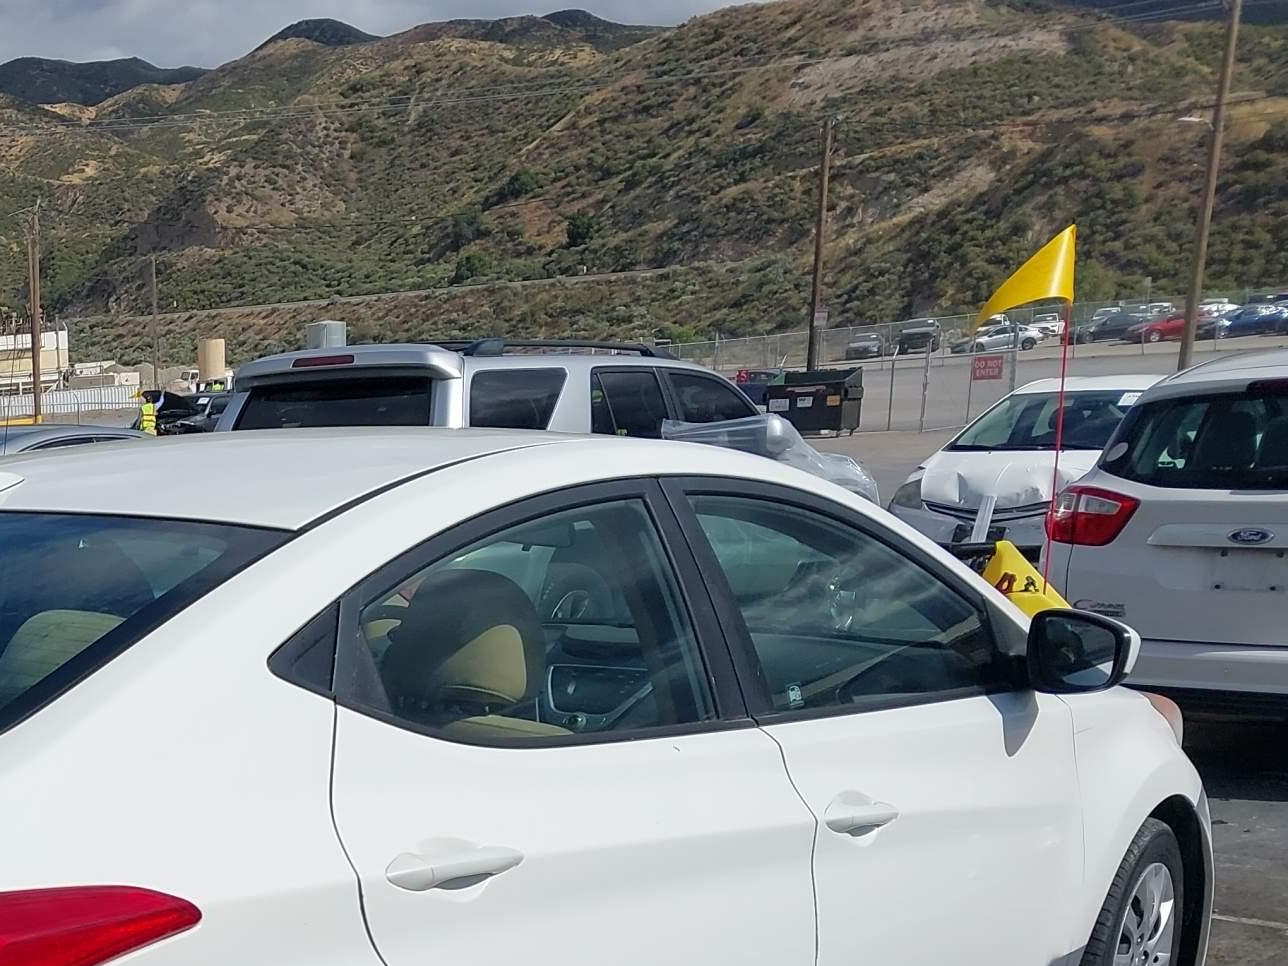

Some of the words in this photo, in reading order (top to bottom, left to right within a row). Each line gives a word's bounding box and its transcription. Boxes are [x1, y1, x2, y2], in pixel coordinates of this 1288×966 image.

[974, 360, 985, 369] DO
[986, 359, 1001, 368] NOT
[975, 368, 999, 377] ENTER
